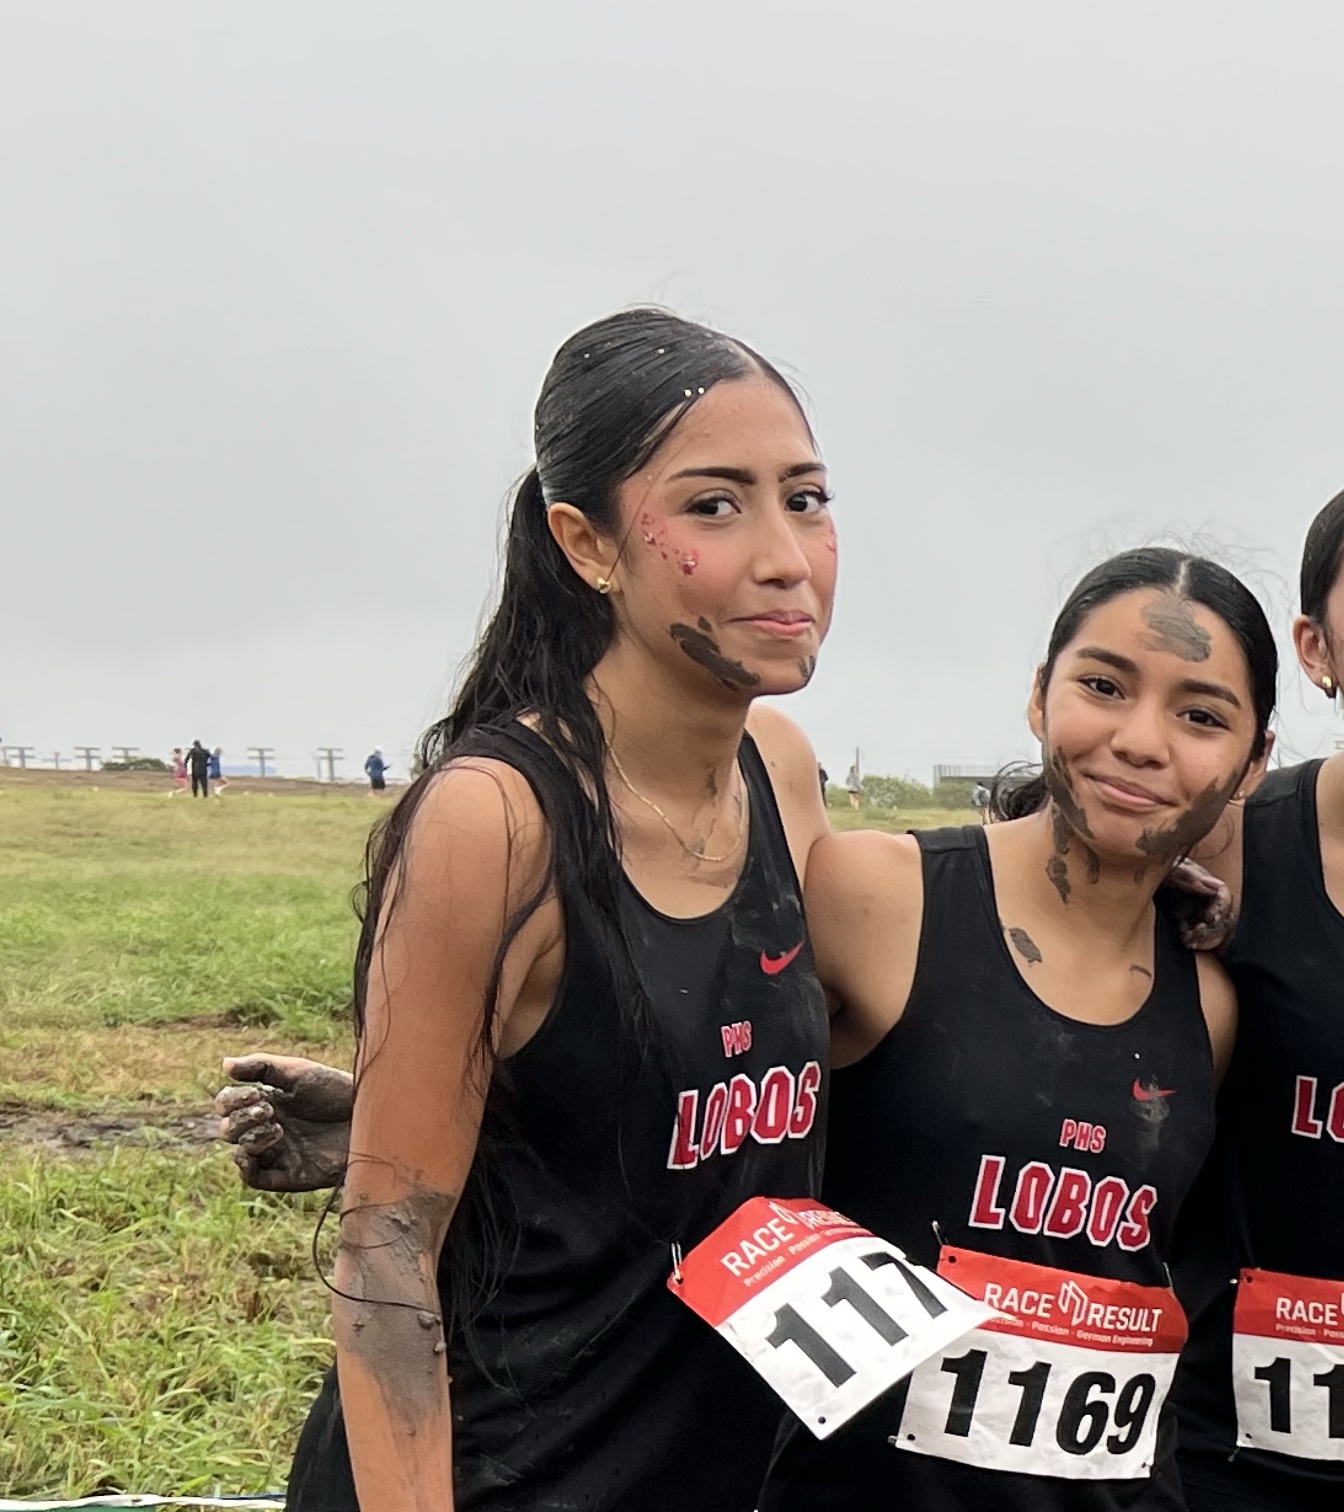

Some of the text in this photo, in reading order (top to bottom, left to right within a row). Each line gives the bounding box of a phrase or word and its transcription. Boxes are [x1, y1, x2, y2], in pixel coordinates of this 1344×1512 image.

[721, 1020, 752, 1057] PHS
[666, 1060, 821, 1169] LOBOS
[1059, 1118, 1106, 1153] PHS
[968, 1154, 1157, 1252] LOBOS
[720, 1217, 794, 1276] RACE
[984, 1283, 1162, 1332] RACE RESULT
[1276, 1297, 1338, 1325] RACE
[941, 1349, 1156, 1455] 1169
